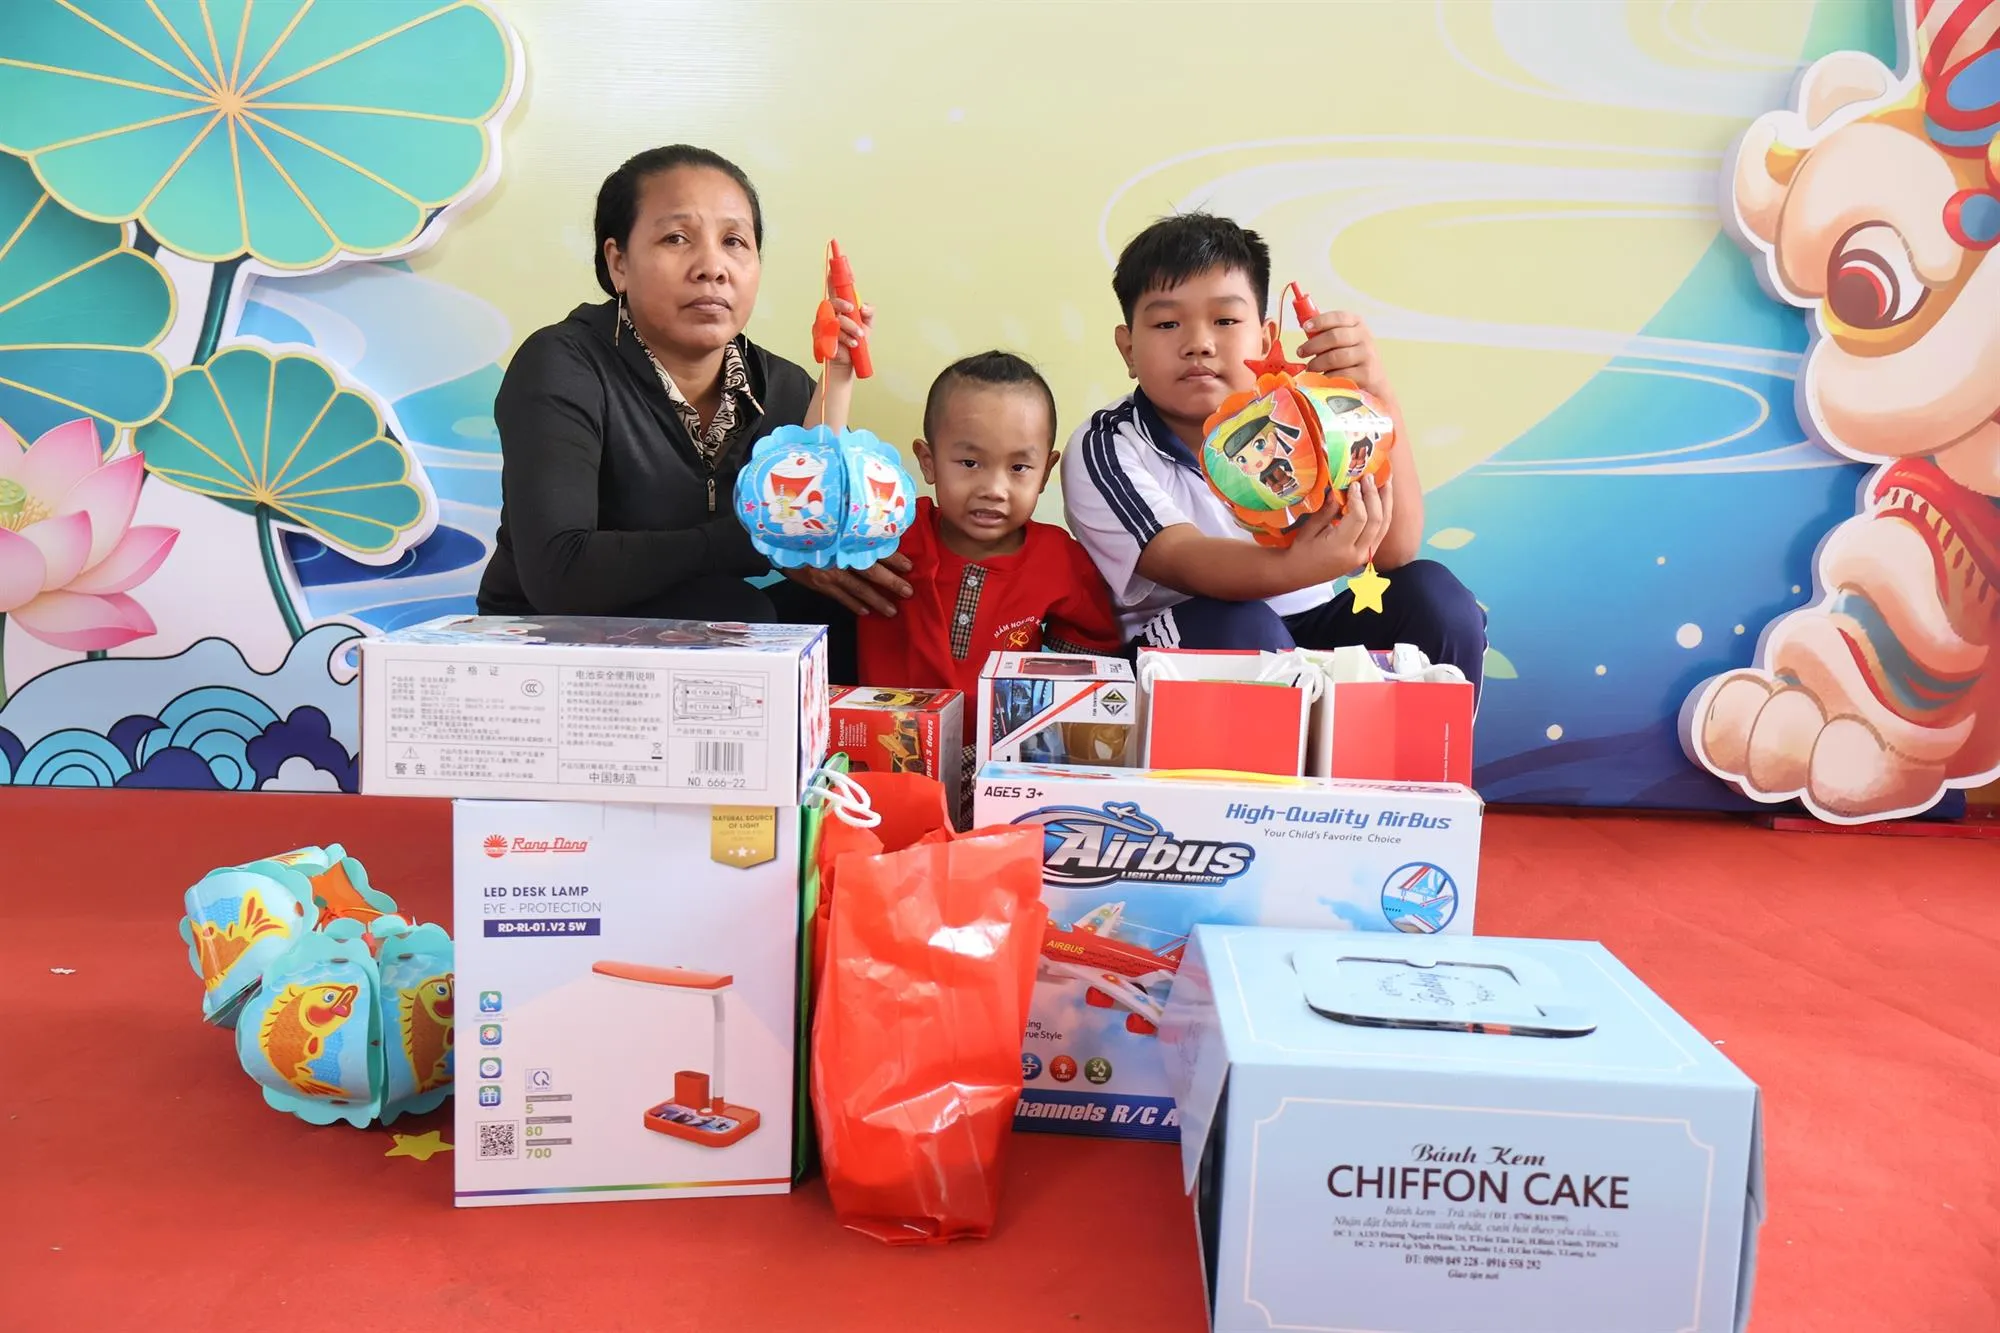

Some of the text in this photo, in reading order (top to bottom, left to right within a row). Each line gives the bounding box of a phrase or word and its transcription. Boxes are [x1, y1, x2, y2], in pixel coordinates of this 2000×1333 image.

[447, 665, 500, 676] 合格证
[576, 670, 655, 681] 电池安全使用说明
[926, 749, 932, 757] 3
[589, 772, 637, 784] 中国制造
[707, 778, 746, 788] 666-22
[984, 786, 1044, 799] AGES 3+
[1225, 803, 1452, 830] High-Quality AirBus
[1264, 828, 1401, 844] Your Child's Favorite Choice
[1046, 823, 1254, 875] Airbus
[1121, 870, 1225, 884] LIGHT AND MUSIC
[484, 886, 589, 897] LED DESK LAMP
[484, 903, 506, 914] EYE
[519, 902, 601, 913] PROTECTION
[498, 922, 586, 932] RD-RL-01.V2 5W
[1047, 940, 1085, 954] AIRBUS
[1026, 1020, 1041, 1030] ing
[1041, 1031, 1062, 1041] Style
[526, 1104, 533, 1114] 5
[1015, 1099, 1107, 1122] hannels
[1110, 1104, 1159, 1125] R/C
[526, 1148, 552, 1159] 700
[1411, 1143, 1547, 1166] Bánh Kem
[1327, 1164, 1629, 1209] CHIFFON CAKE
